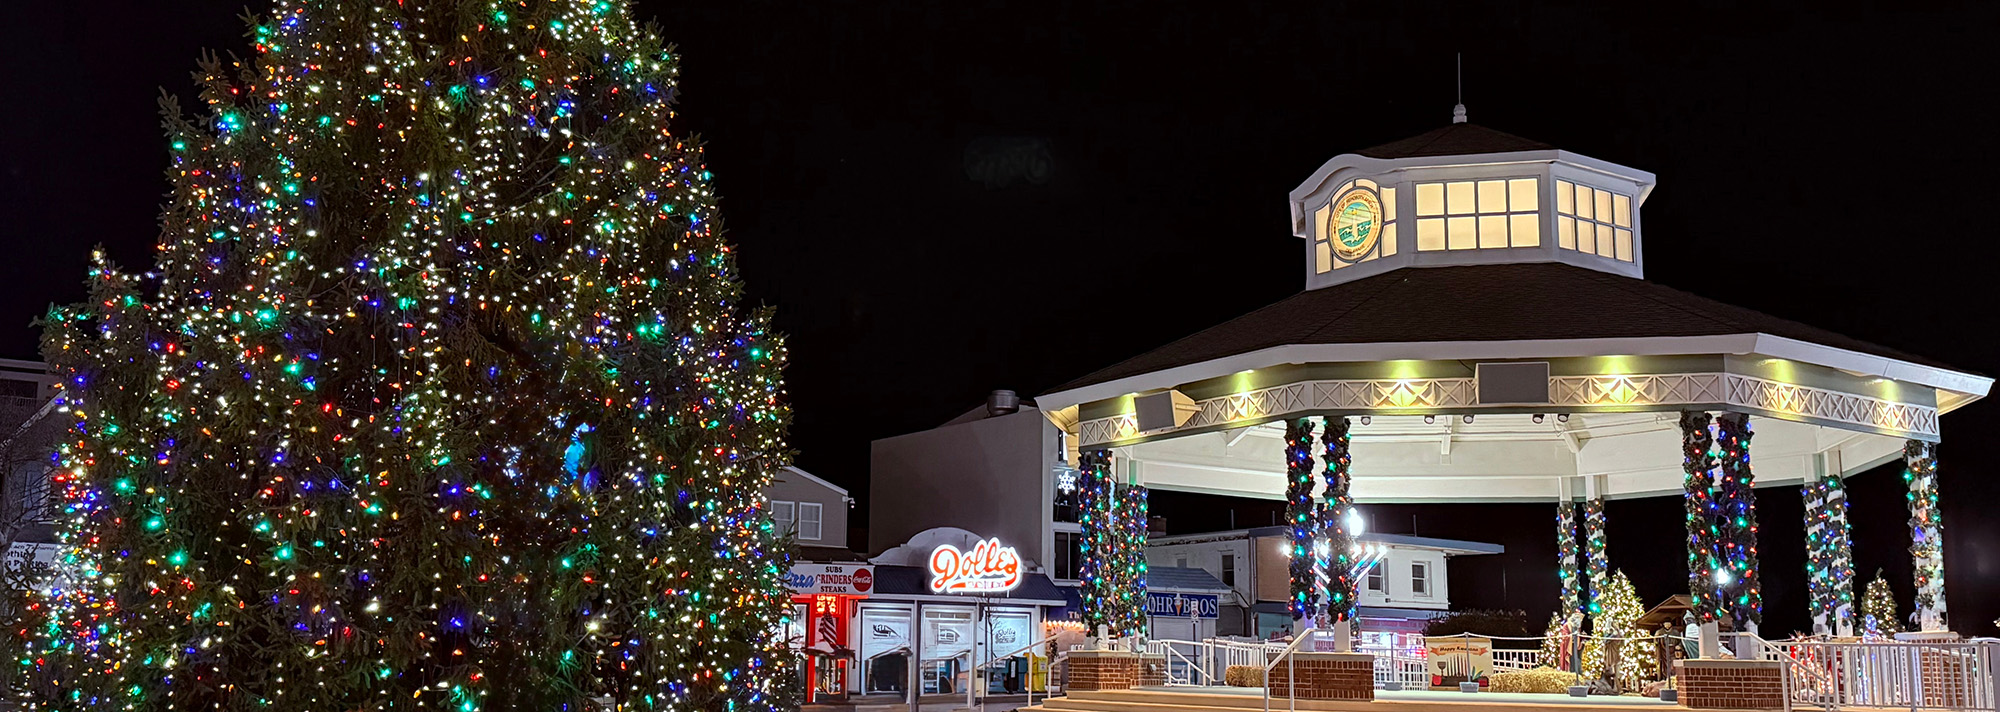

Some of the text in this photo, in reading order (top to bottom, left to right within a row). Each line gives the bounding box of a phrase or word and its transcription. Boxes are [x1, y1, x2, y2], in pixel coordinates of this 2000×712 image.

[784, 569, 815, 588] izza
[815, 574, 852, 585] GRINDERS
[1147, 595, 1174, 613] OHR
